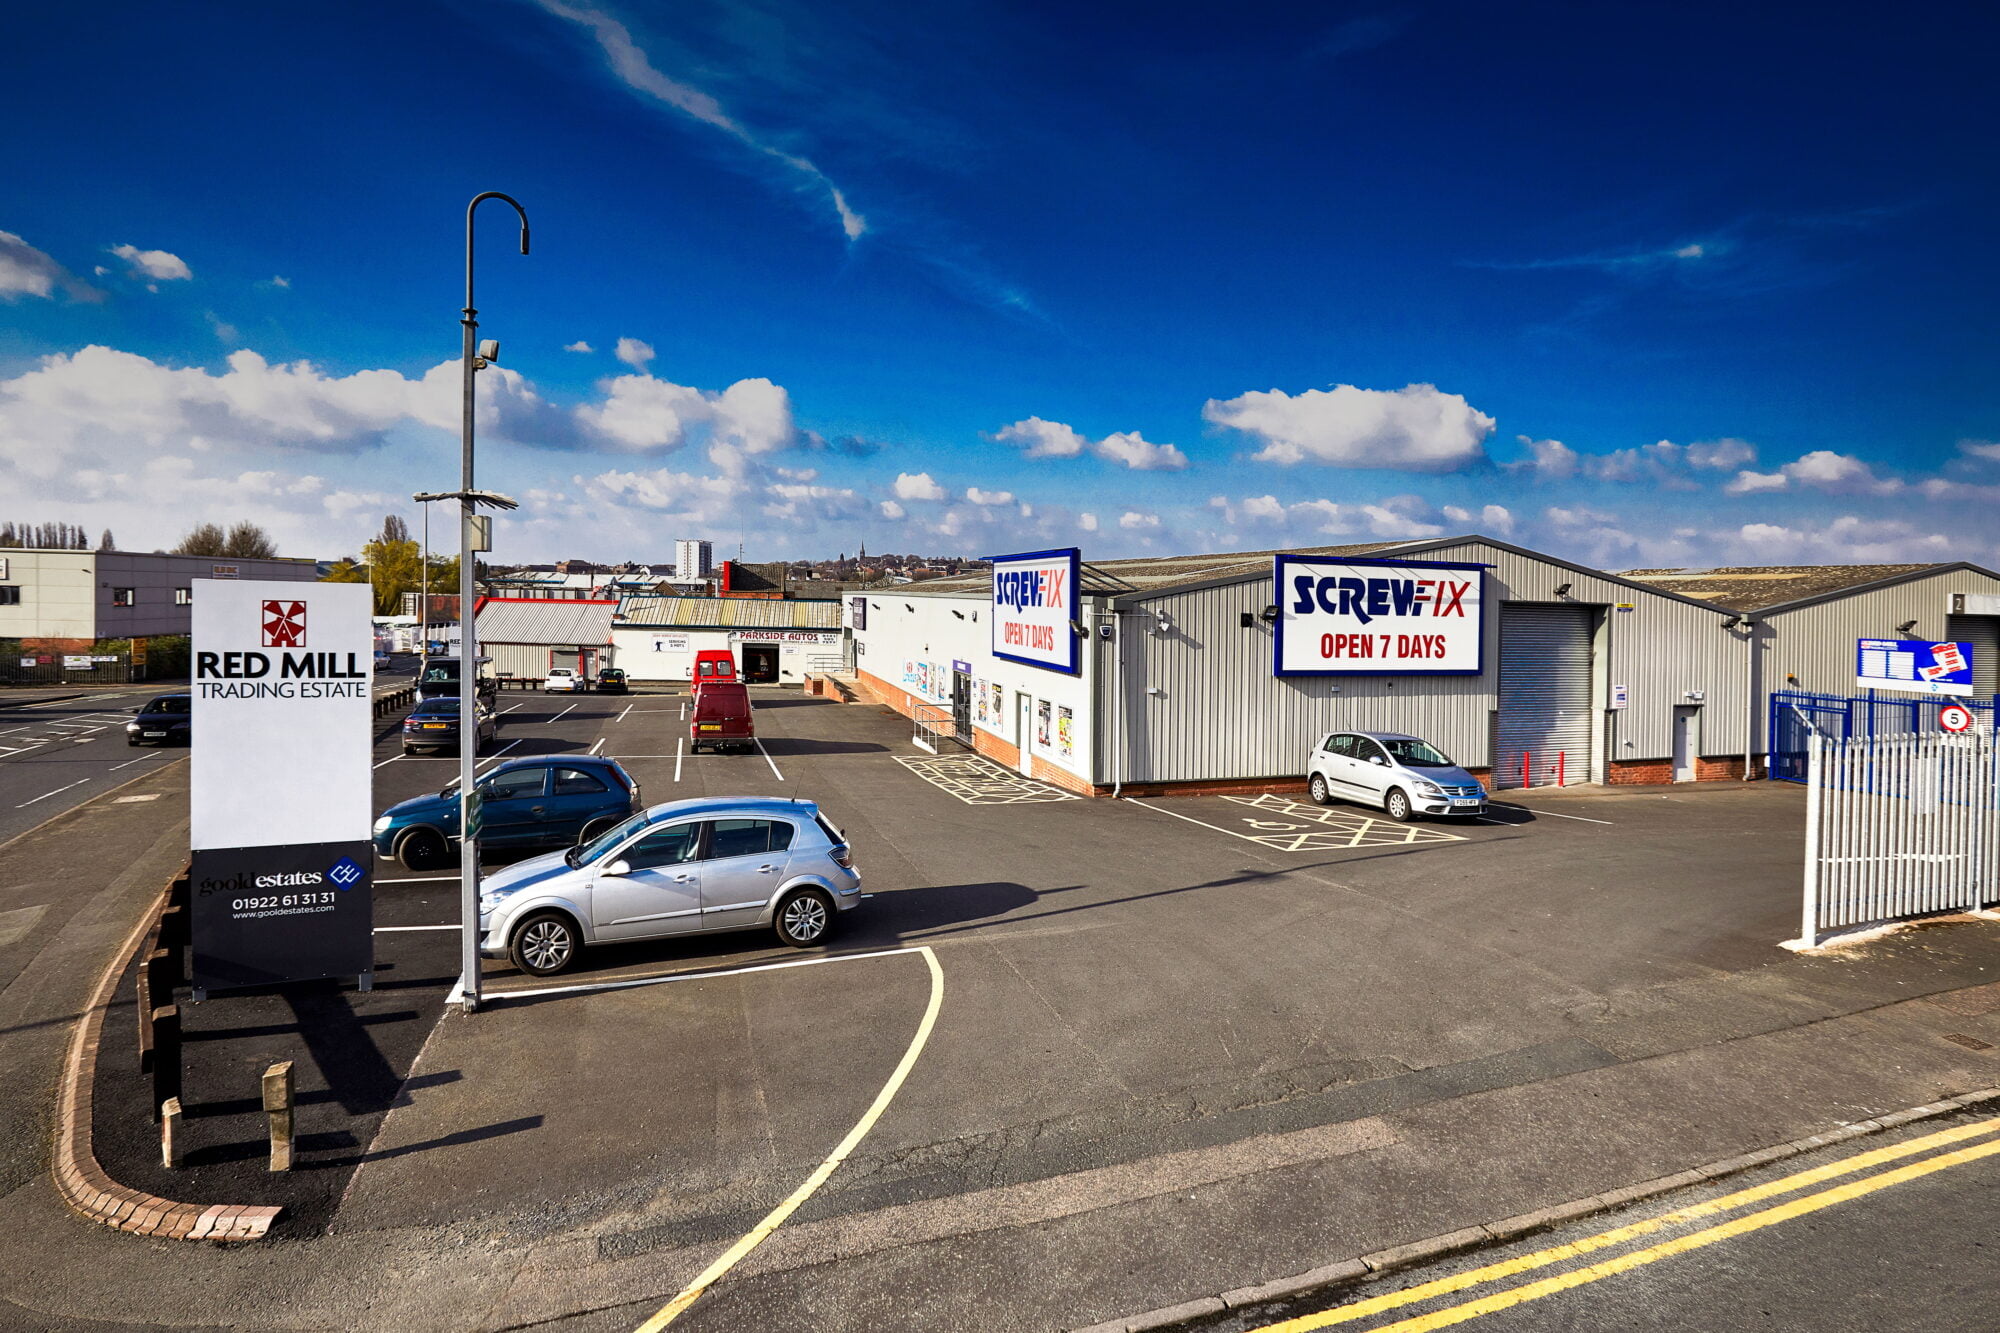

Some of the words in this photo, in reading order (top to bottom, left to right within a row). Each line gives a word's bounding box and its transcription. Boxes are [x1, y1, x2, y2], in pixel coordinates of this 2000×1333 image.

[997, 569, 1066, 614] SCREWFIX
[1293, 575, 1472, 625] SCREWFIX
[1955, 598, 1962, 610] 2
[739, 631, 785, 640] PARKSIDE
[788, 632, 819, 641] AUTOS
[1004, 621, 1024, 646] OPEN
[1025, 624, 1030, 647] 7
[1032, 624, 1054, 652] DAYS
[1321, 633, 1373, 659] OPEN
[1380, 634, 1391, 659] 7
[1397, 634, 1446, 659] DAYS
[197, 651, 271, 679] RED
[280, 652, 367, 679] MILL
[197, 682, 295, 699] TRADING
[300, 682, 367, 698] ESTATE
[1950, 713, 1959, 724] 5
[232, 896, 278, 910] 01922
[282, 895, 298, 906] 61
[301, 893, 317, 905] 31
[320, 892, 335, 903] 31
[232, 904, 335, 919] www.gooldestates.com
